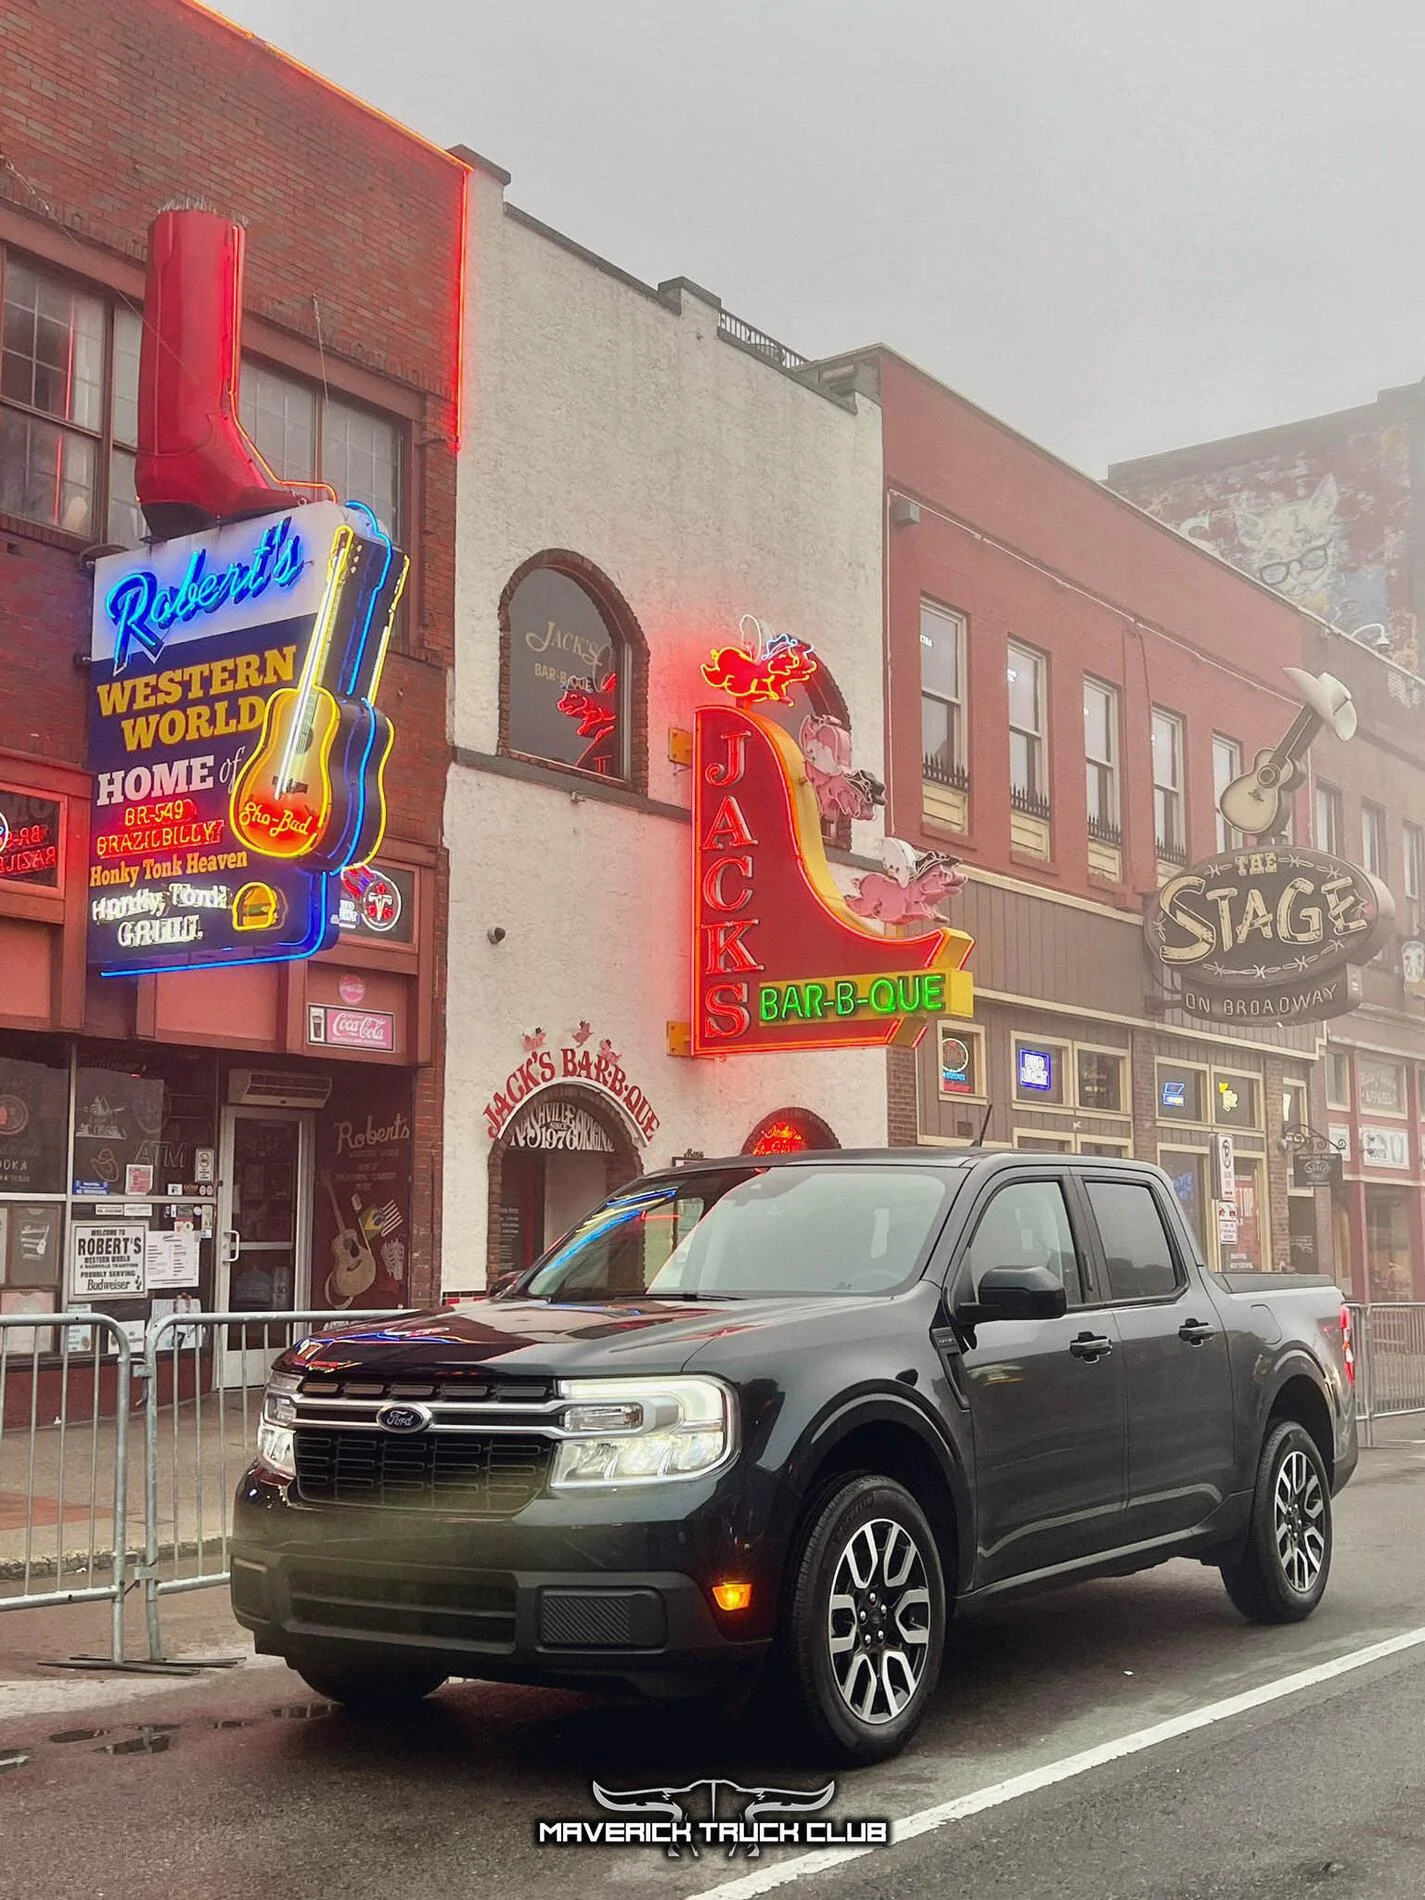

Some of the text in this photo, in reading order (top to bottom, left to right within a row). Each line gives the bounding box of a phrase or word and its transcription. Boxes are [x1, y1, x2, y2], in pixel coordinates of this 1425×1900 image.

[104, 516, 303, 676] Robert's
[96, 645, 297, 717] WESTERN
[121, 694, 268, 752] WORLD
[96, 745, 246, 806] HOME of
[125, 798, 186, 827] BR-549
[89, 850, 248, 888] Honky Tonk Heaven
[1233, 853, 1279, 877] THE
[1158, 875, 1369, 966] STAGE
[760, 974, 946, 1022] BAR-B-QUE
[1185, 982, 1338, 1017] ON BROADWAY
[482, 1050, 556, 1140] JACK'S
[539, 1127, 578, 1150] 1976
[78, 1237, 142, 1256] ROBERT'S
[87, 1279, 131, 1290] Budweiser
[387, 1410, 413, 1426] Ford
